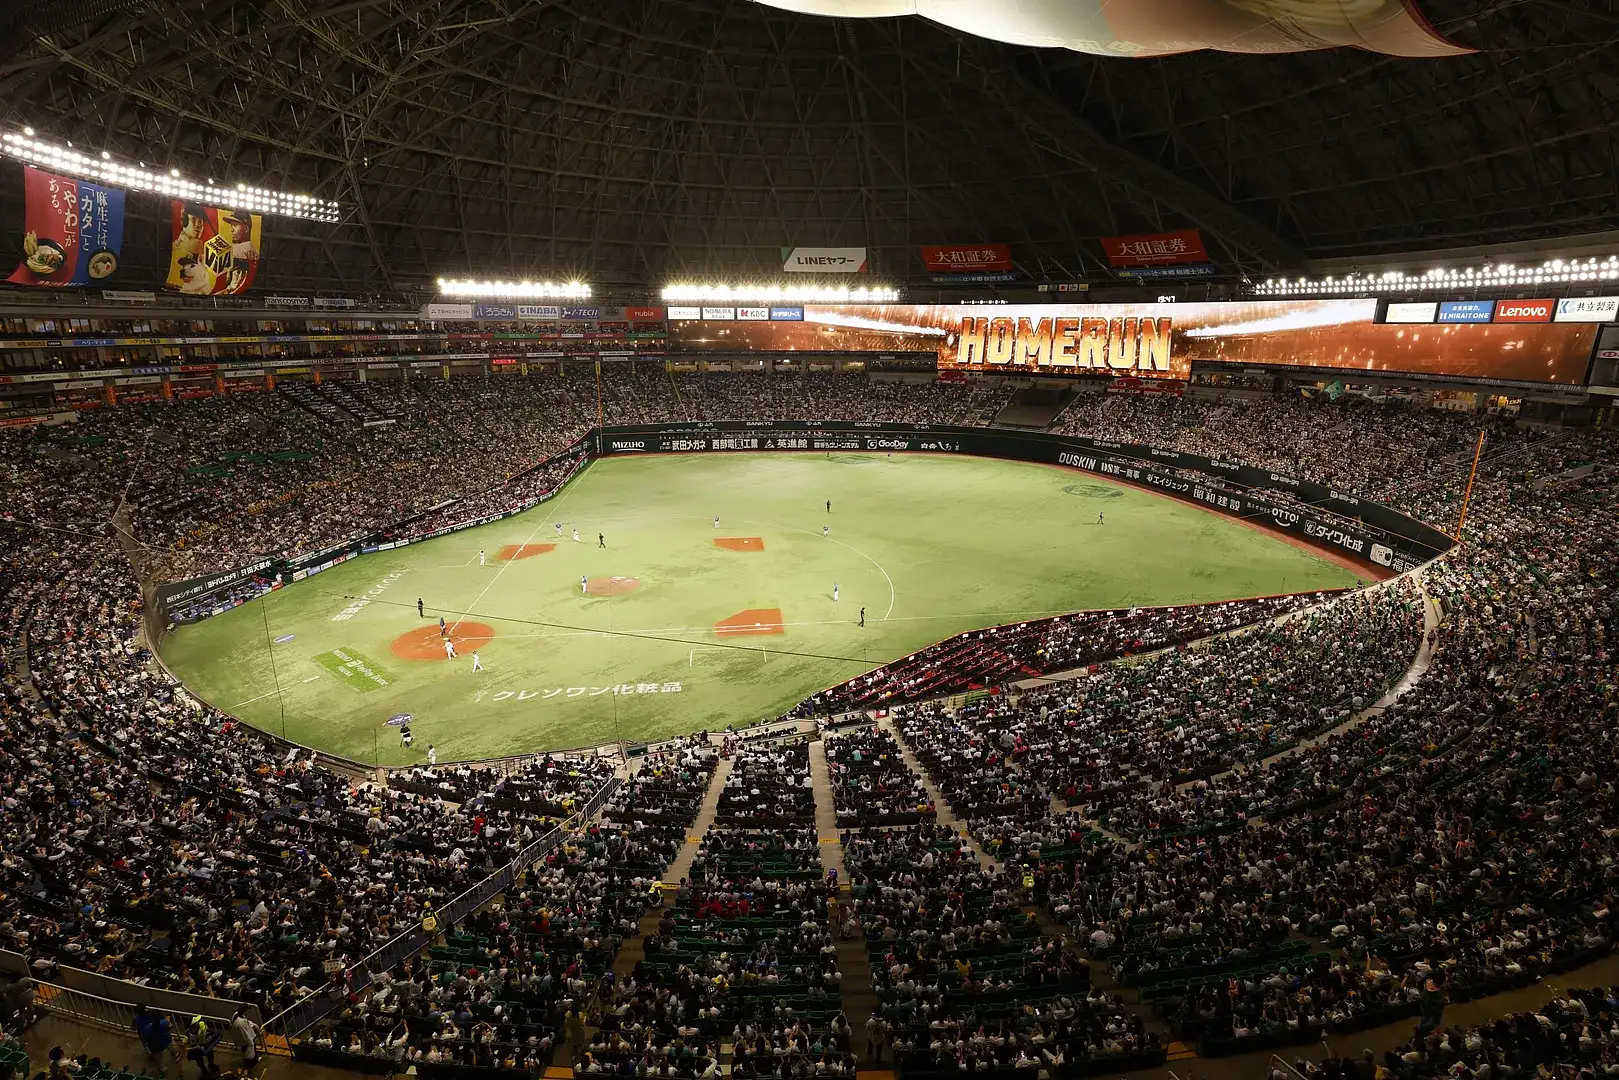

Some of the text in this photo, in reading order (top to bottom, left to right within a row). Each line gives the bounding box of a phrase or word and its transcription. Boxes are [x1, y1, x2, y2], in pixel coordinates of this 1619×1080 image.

[49, 178, 62, 215] ある。
[63, 181, 77, 247] 「やわ」が
[81, 186, 94, 251] 「カタ」と
[1117, 238, 1187, 255] 大和証券
[797, 257, 855, 265] LINEヤフー
[935, 249, 997, 262] 大和証券
[266, 298, 309, 306] transcosmos
[1576, 302, 1616, 312] 共立製薬
[485, 307, 514, 317] ろうきん
[526, 307, 558, 316] INABA
[1499, 305, 1546, 317] Lenovo
[958, 316, 1173, 371] HOMERUN
[1477, 377, 1500, 385] XPERIA
[1554, 383, 1581, 392] XPERIA
[612, 441, 645, 449] MIZUHO
[672, 440, 706, 450] 武田メガネ
[777, 439, 808, 449] 英進館
[878, 439, 909, 449] GooDay
[1058, 452, 1097, 471] DUSKIN
[1152, 475, 1189, 492] エイジェック
[1193, 488, 1241, 512] 昭和建設
[1271, 507, 1300, 524] OTTO!
[1315, 525, 1364, 553] ダイワ化成
[207, 572, 237, 589] ヨドバシカメラ
[166, 585, 204, 603] 西日本シティ銀行
